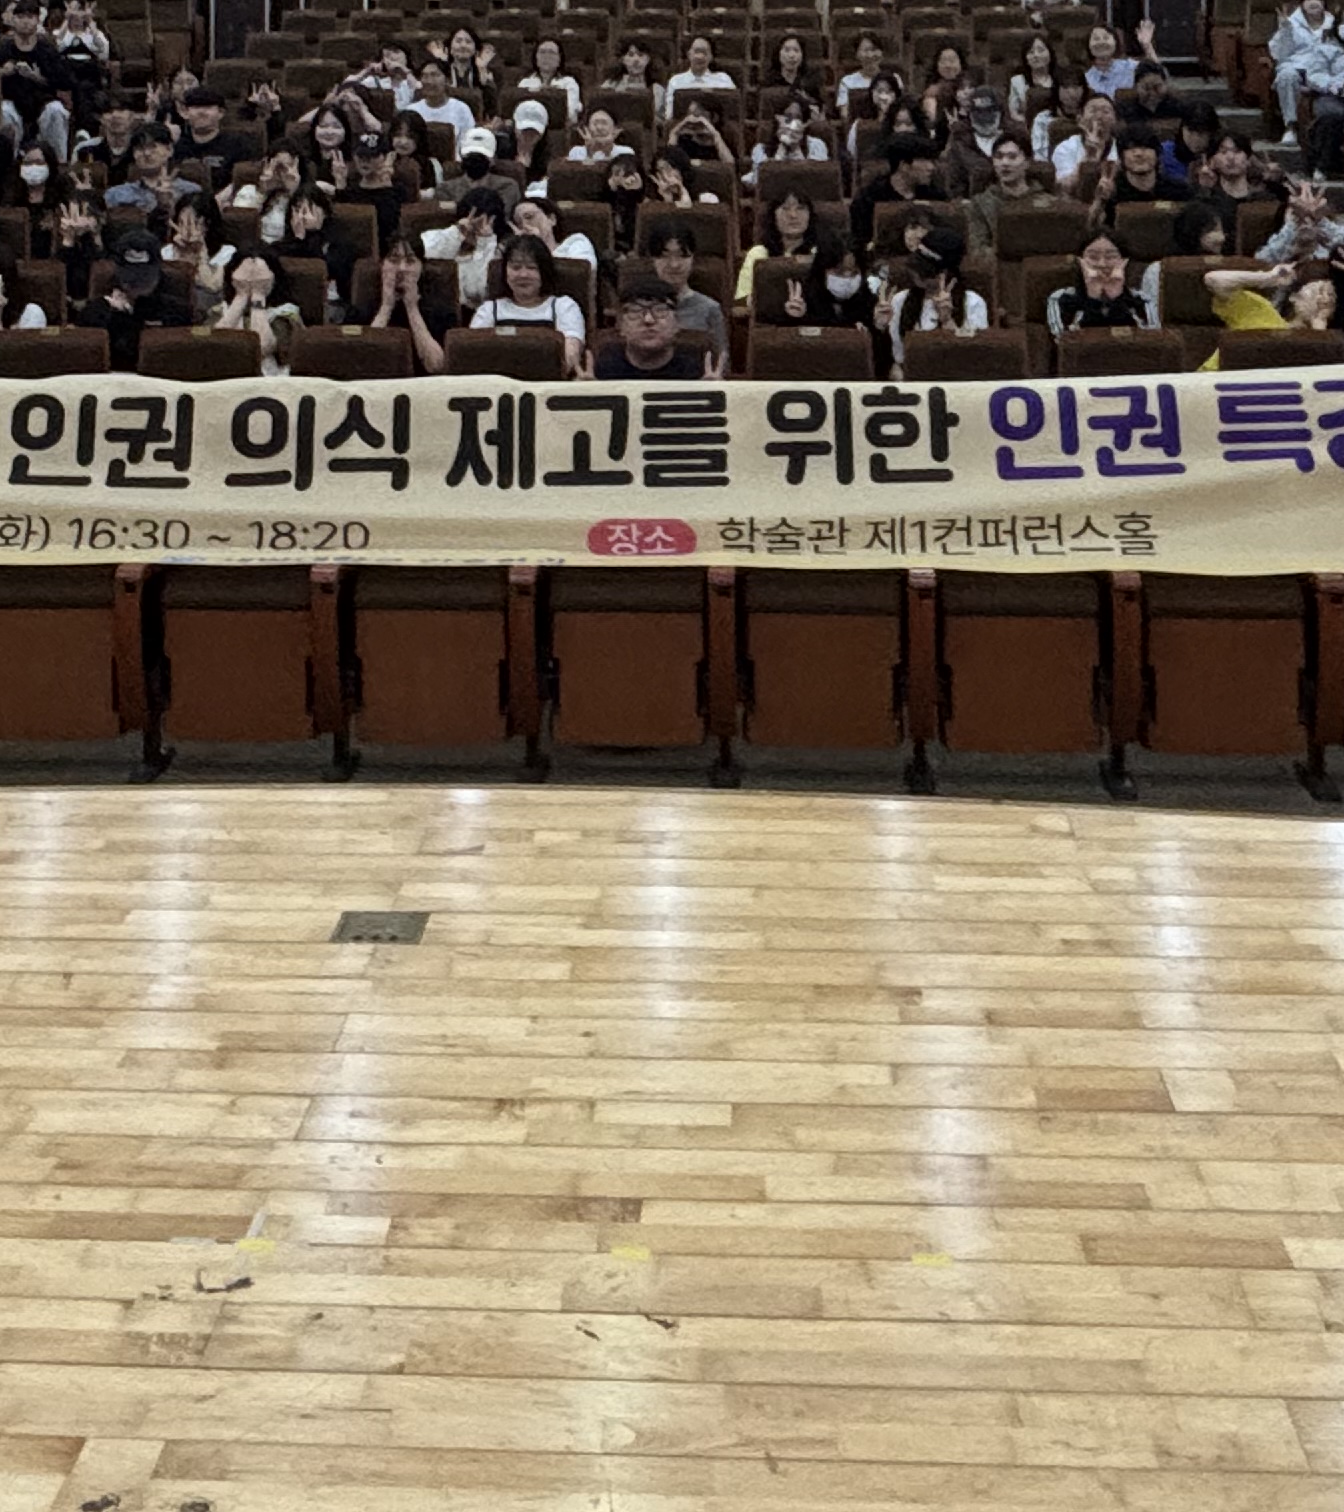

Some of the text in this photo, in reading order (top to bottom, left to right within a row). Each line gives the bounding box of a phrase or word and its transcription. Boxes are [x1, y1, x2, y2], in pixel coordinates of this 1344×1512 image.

[7, 393, 196, 490] 인권
[223, 393, 412, 492] 의식
[442, 390, 732, 490] 제고를
[763, 386, 961, 486] 위한
[986, 384, 1188, 481] 인권
[67, 517, 191, 551] 16:30
[247, 520, 371, 551] 18:20
[605, 511, 1159, 557] 장소 학술관 제1컨퍼런스홀
